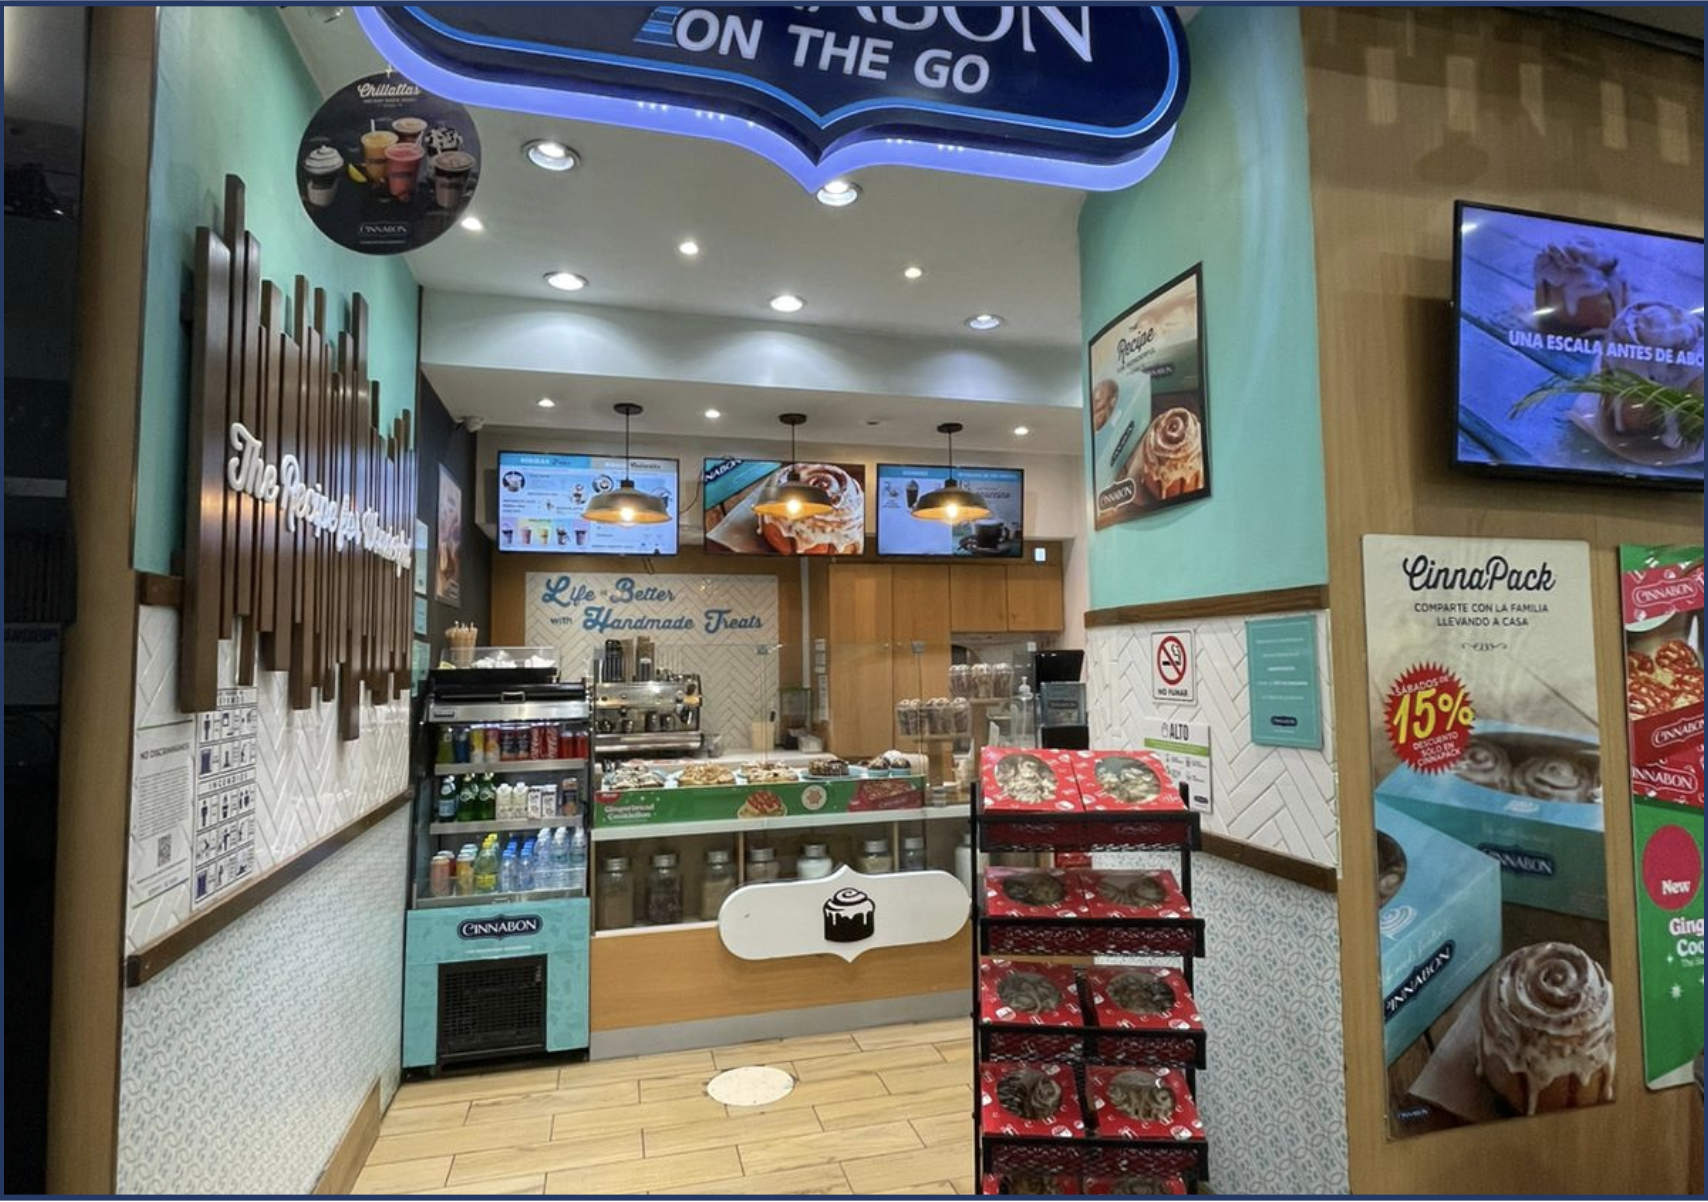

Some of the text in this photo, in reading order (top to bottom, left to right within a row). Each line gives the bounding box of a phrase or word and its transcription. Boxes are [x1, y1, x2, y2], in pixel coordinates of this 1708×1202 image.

[676, 9, 990, 93] ON THE GO
[1117, 327, 1154, 364] Recipe
[1508, 329, 1544, 350] UNA
[1547, 334, 1602, 356] ESCALA
[1607, 341, 1654, 361] ANTES
[1655, 347, 1674, 363] DE
[228, 422, 280, 503] The
[281, 453, 339, 538] Recipe
[1402, 554, 1556, 591] CinnaPack
[542, 576, 597, 607] Life
[609, 577, 676, 604] Better
[550, 606, 763, 633] with Handmade Treats
[1413, 602, 1549, 613] COMPARTE CON LA FAMILIA
[1436, 616, 1529, 627] LLEVANDO A CASA
[1157, 688, 1188, 697] NO FUMAR
[1393, 688, 1475, 744] 15%
[1169, 723, 1189, 741] ALTO
[1662, 880, 1691, 896] New
[463, 919, 537, 936] CINNABON
